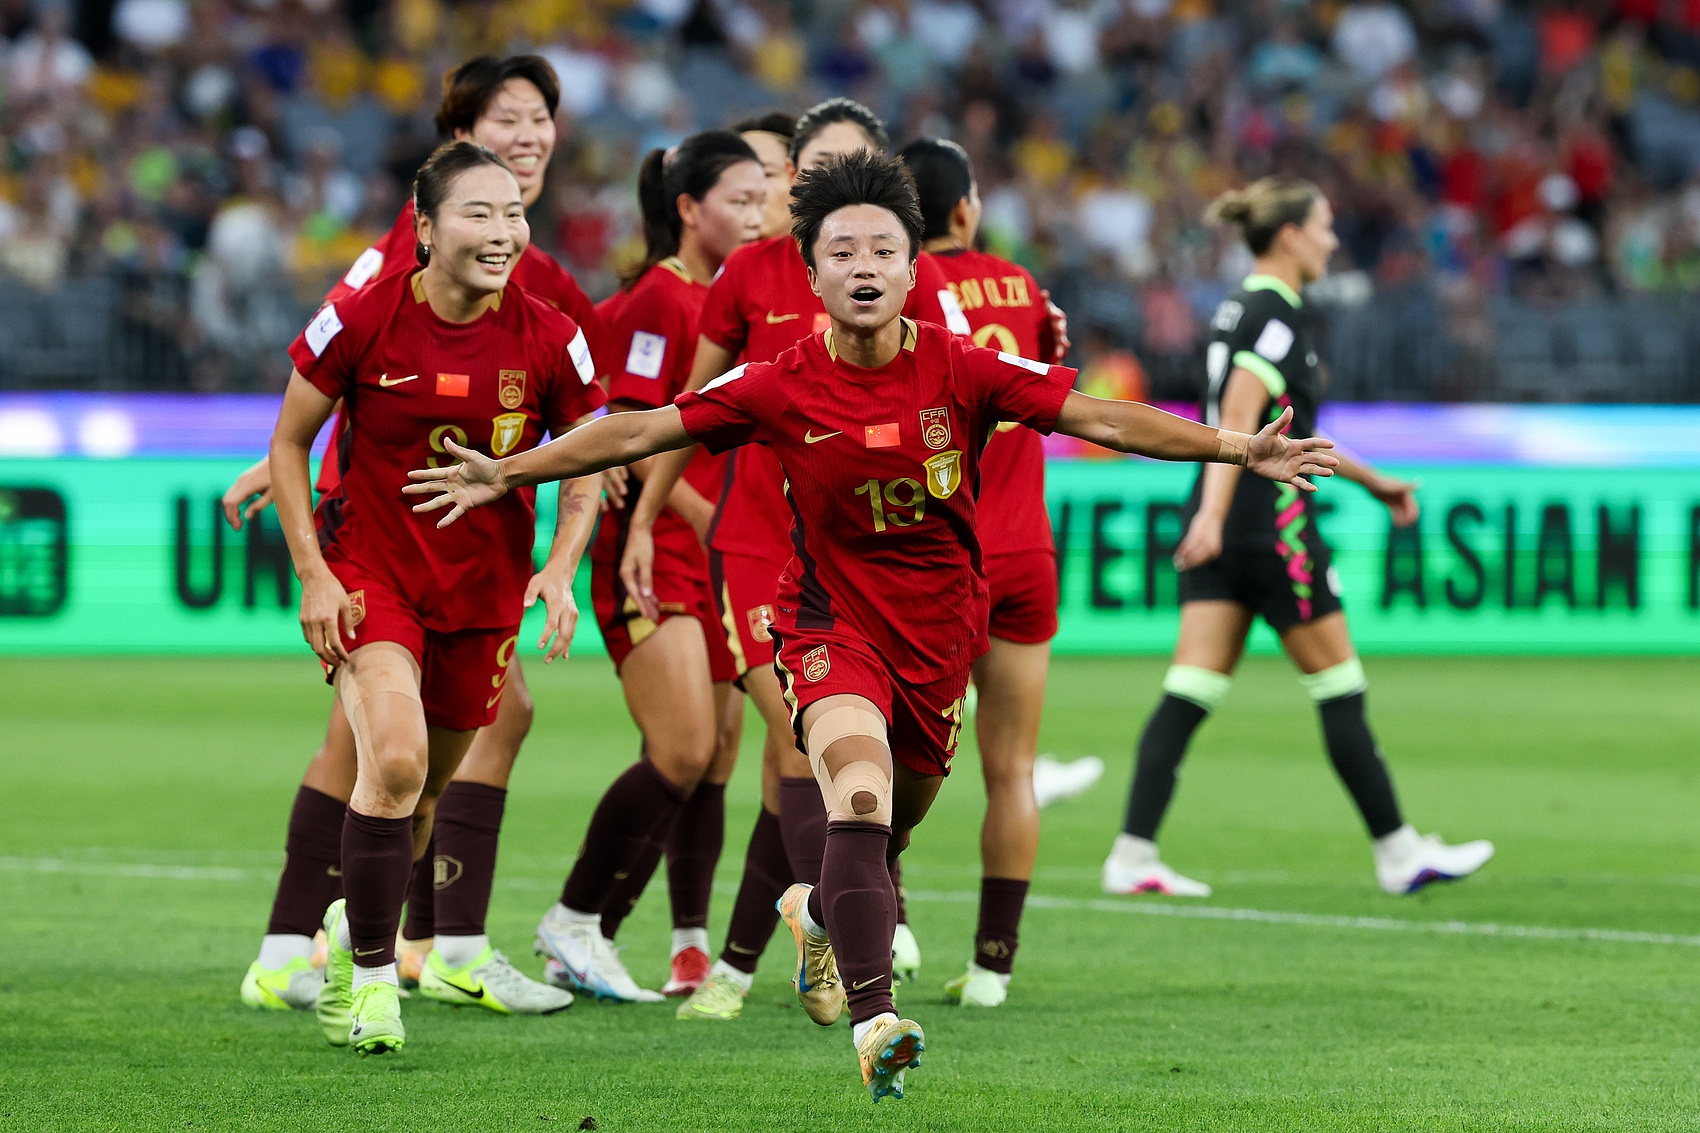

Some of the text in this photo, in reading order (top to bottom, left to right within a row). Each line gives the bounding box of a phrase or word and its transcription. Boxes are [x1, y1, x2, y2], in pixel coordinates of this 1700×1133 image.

[922, 410, 946, 421] CFA
[427, 424, 468, 469] 9
[854, 477, 926, 533] 19
[1380, 501, 1639, 611] ASIAN
[804, 647, 826, 663] CFA
